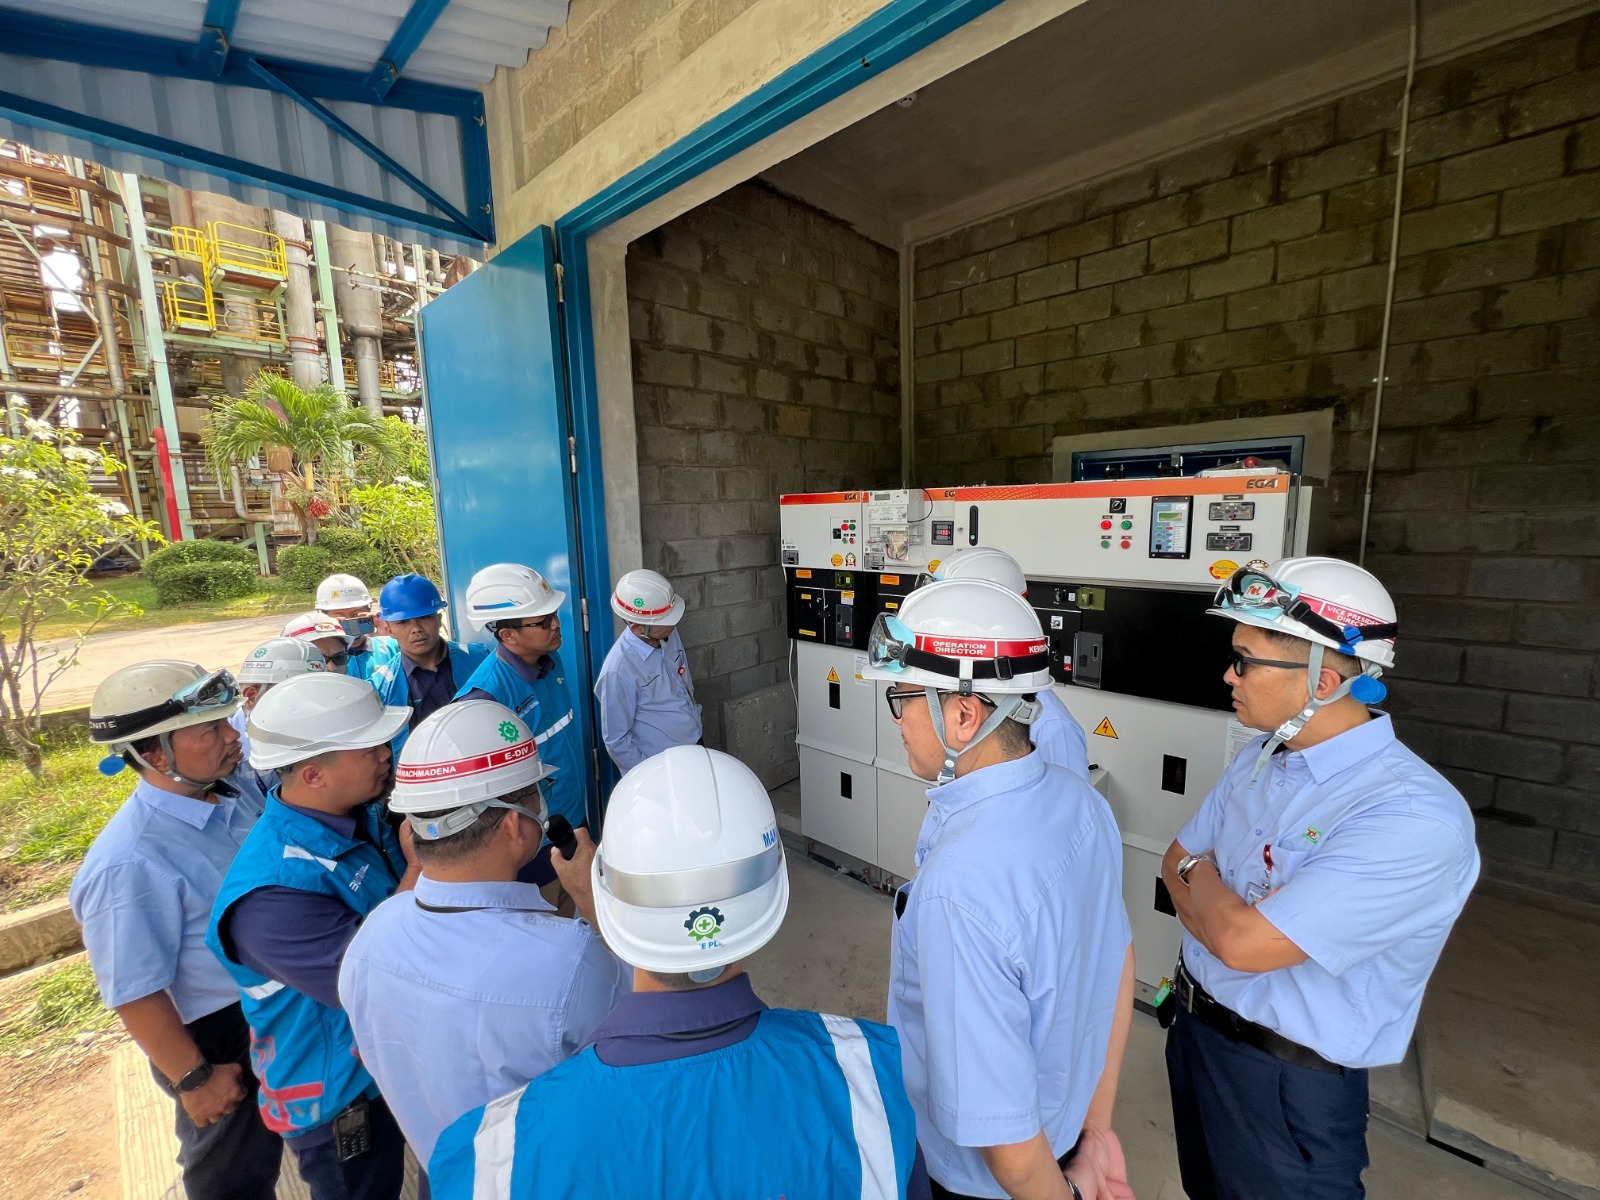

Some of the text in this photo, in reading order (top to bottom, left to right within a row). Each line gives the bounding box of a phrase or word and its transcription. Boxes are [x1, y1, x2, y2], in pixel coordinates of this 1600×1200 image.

[1327, 605, 1346, 616] VICE
[932, 640, 987, 650] OPERATION
[934, 647, 984, 656] DIRECTOR
[504, 746, 529, 761] E-DIV
